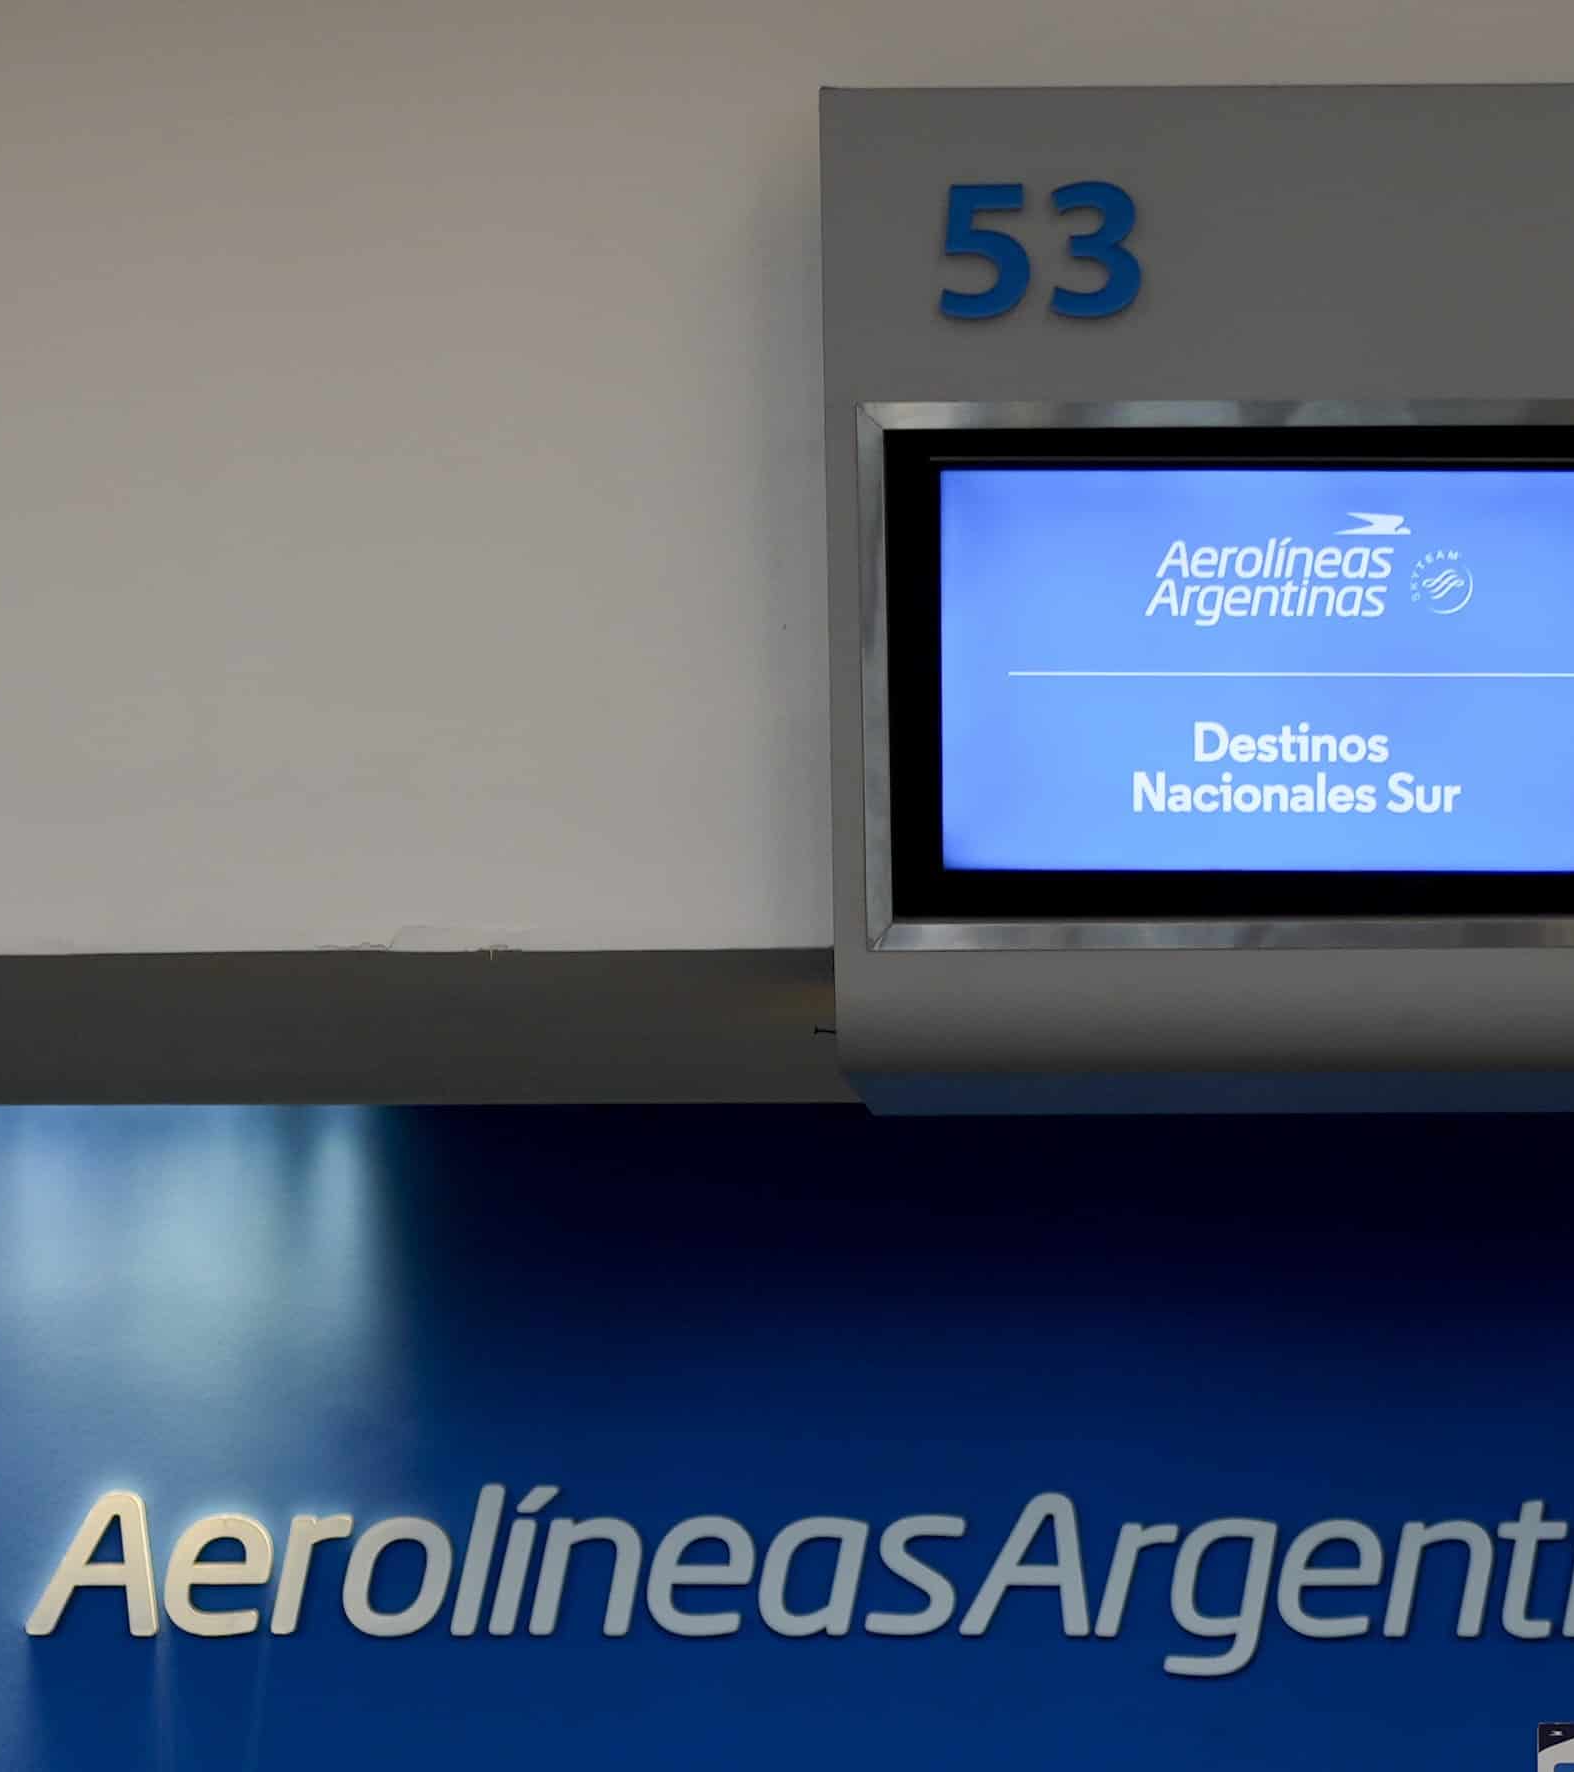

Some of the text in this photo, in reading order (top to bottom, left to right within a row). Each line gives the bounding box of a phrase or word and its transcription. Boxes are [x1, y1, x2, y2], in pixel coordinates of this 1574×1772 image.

[937, 181, 1144, 321] 53
[1156, 537, 1395, 579] Aerolíneas
[1145, 579, 1388, 627] Argentinas
[1194, 721, 1389, 763] Destinos
[1133, 771, 1462, 813] Nacionales Sur
